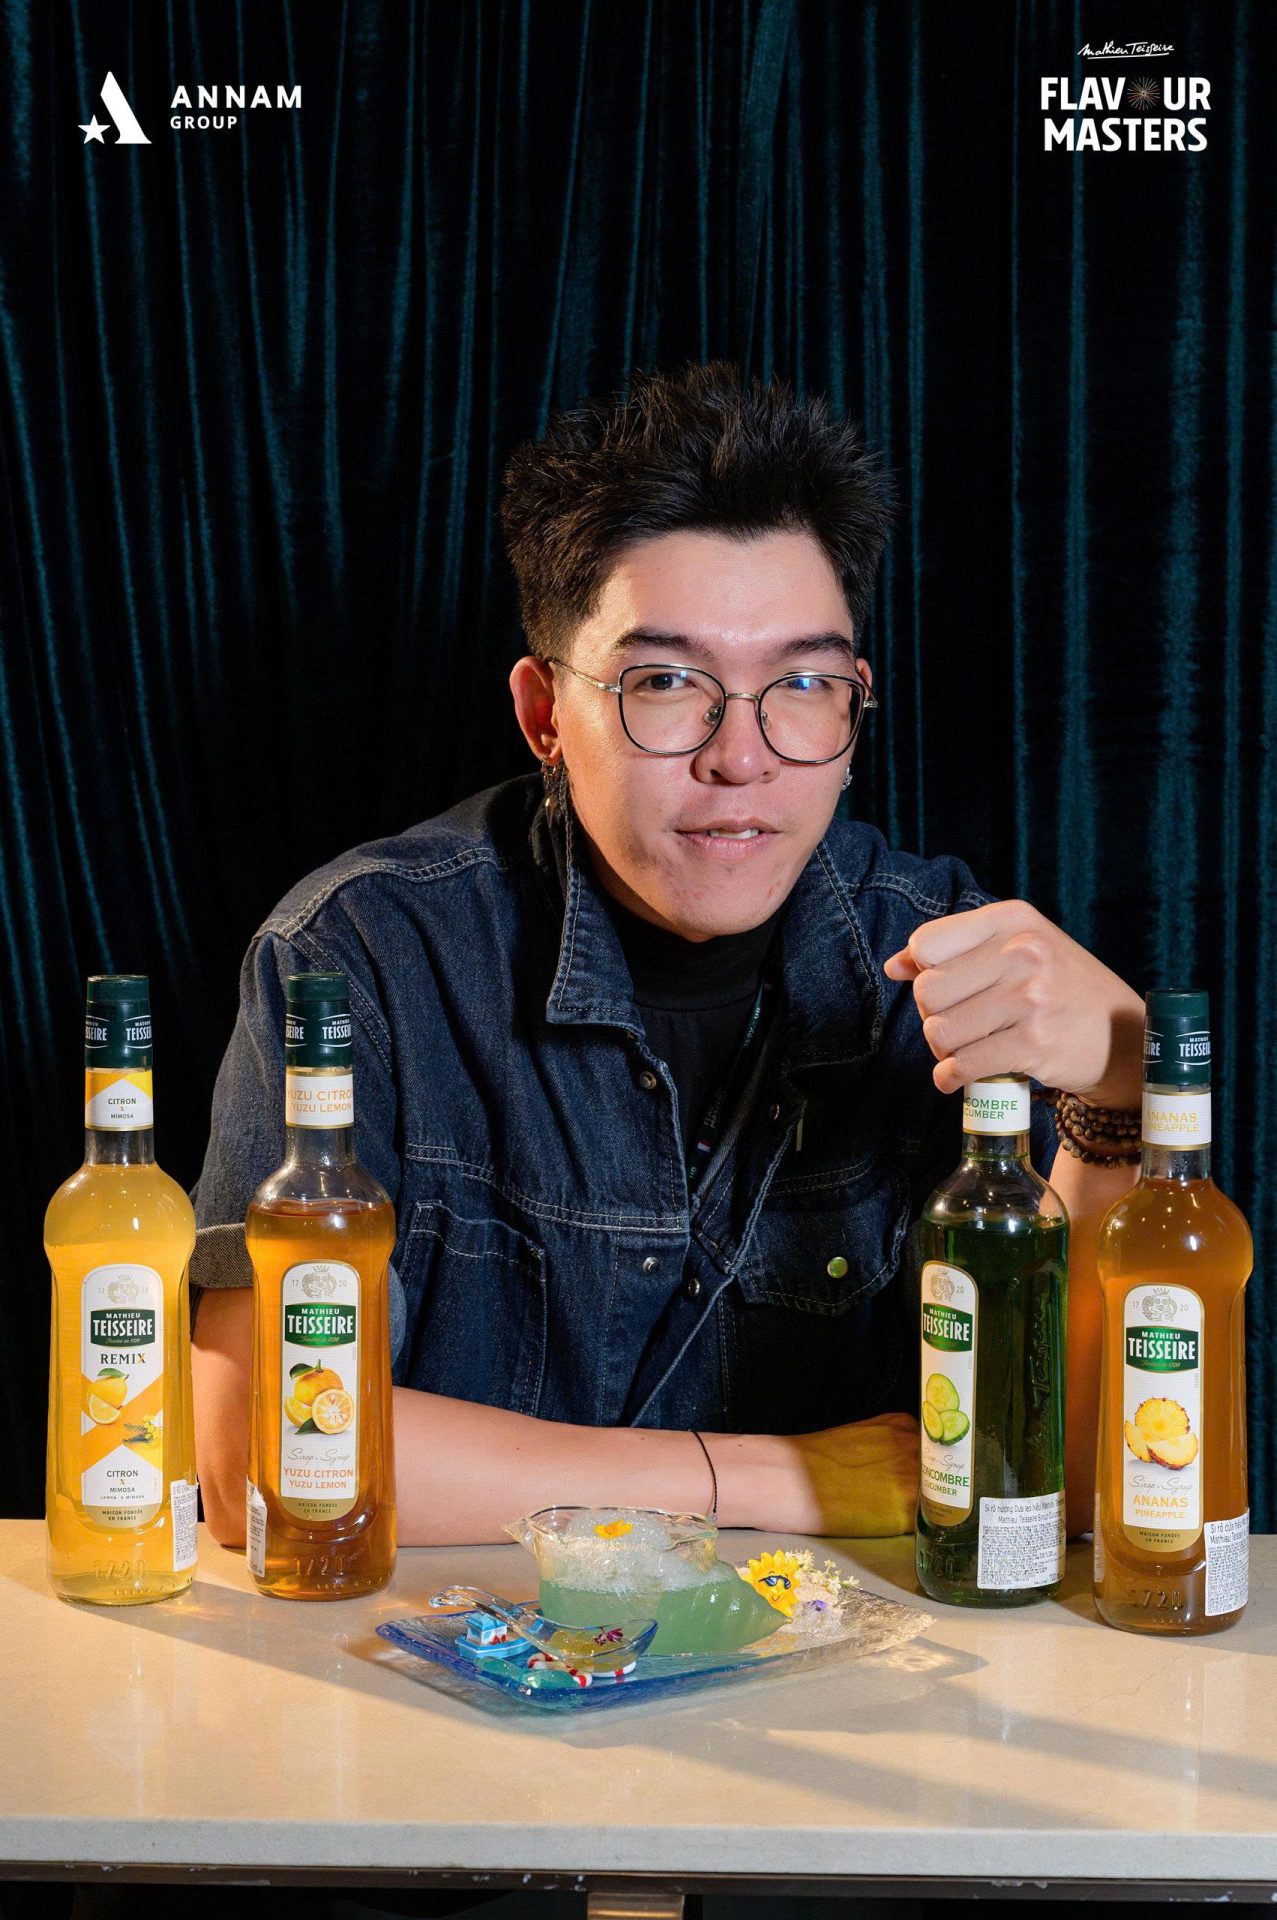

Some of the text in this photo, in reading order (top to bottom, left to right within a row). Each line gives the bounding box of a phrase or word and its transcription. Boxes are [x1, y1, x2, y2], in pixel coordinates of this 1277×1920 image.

[292, 1102, 316, 1112] YUZU
[965, 1096, 1018, 1111] COMBRE
[964, 1107, 1005, 1119] CUMBER
[1151, 1122, 1199, 1132] NEAPPLE
[929, 1308, 957, 1320] MATHIEU
[93, 1319, 153, 1337] TEISSEIRE
[287, 1315, 354, 1335] TEISSEIRE
[922, 1313, 970, 1342] TEISSEIRE
[1141, 1331, 1181, 1340] MATHIEU
[1127, 1337, 1196, 1360] TEISSEIRE
[101, 1352, 146, 1365] REMIX
[106, 1470, 139, 1478] CITRON
[284, 1467, 353, 1478] YUZU CITRON
[290, 1480, 347, 1489] YUZU LEMON
[1133, 1494, 1188, 1508] ANANAS
[1135, 1509, 1185, 1519] PINEAPPLE
